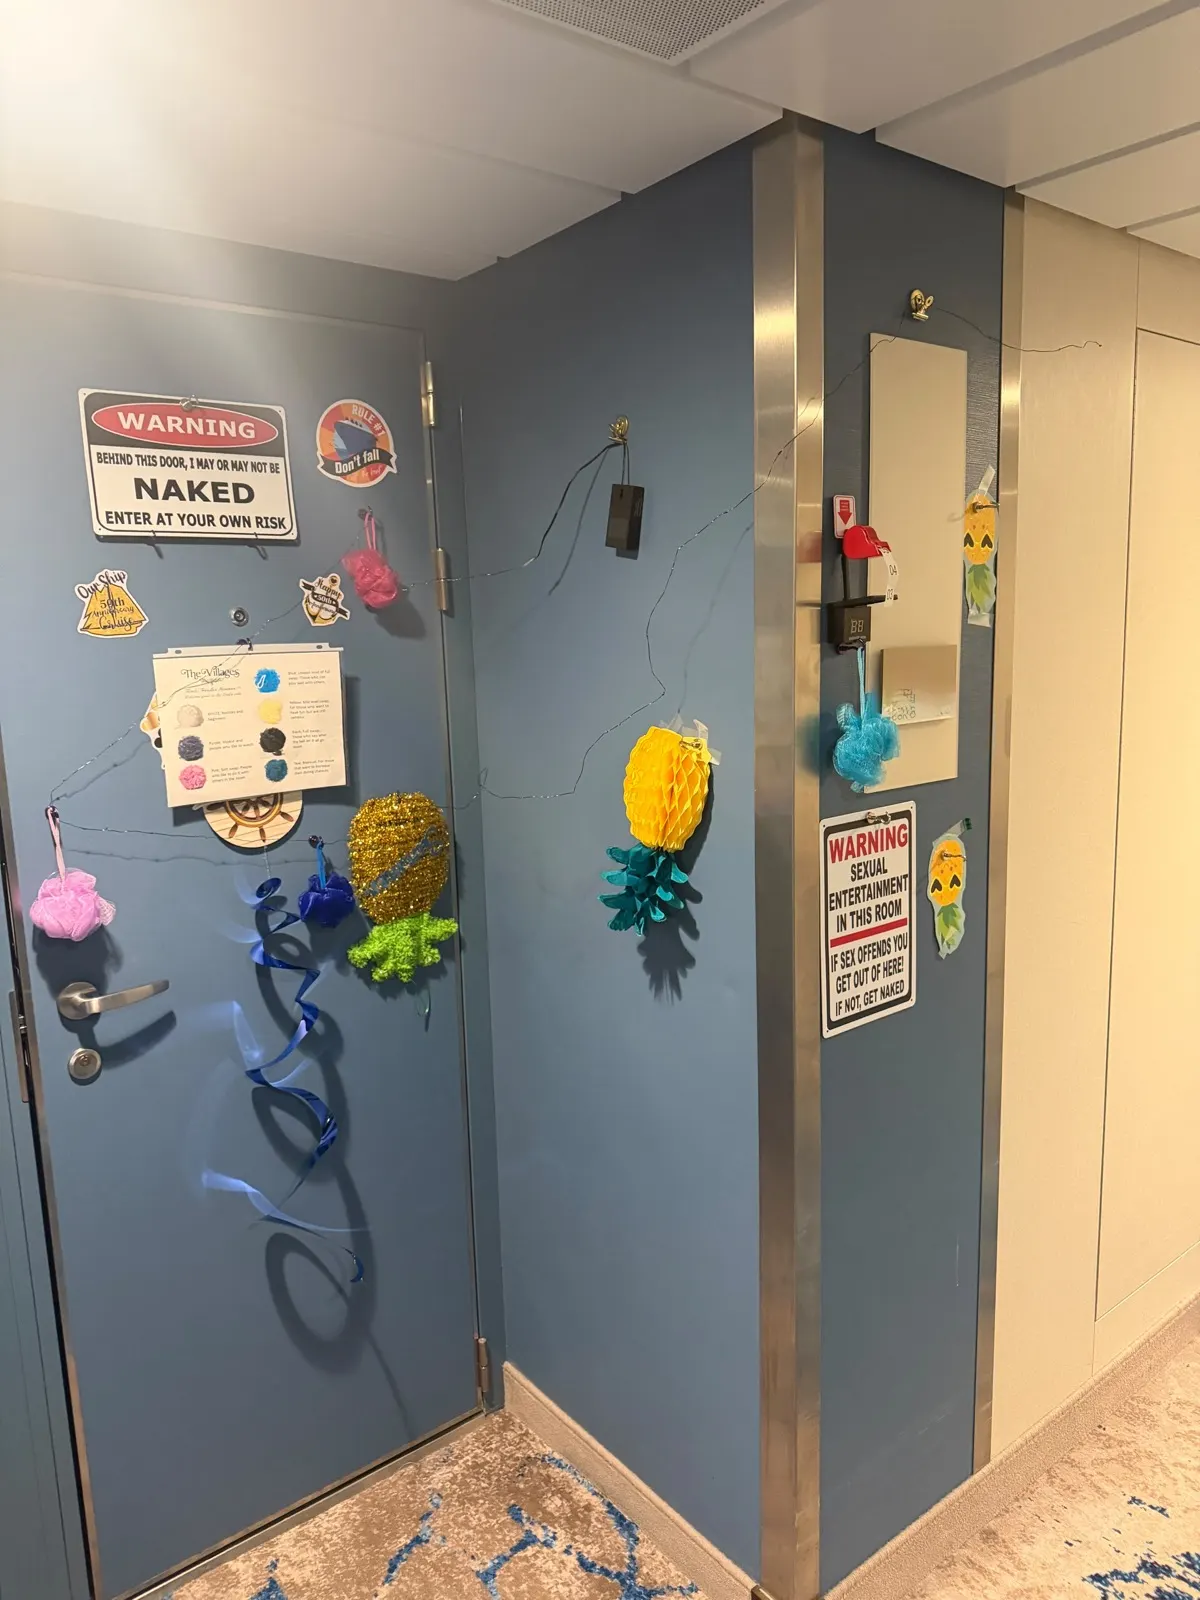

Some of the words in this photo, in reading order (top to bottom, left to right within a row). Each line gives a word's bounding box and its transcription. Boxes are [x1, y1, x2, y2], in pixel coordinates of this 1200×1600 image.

[118, 411, 256, 438] WARNING
[352, 404, 375, 424] RULE
[374, 422, 386, 436] #1
[96, 452, 133, 466] BEHIND
[135, 454, 157, 467] THIS
[160, 455, 188, 470] DOOR,
[190, 457, 195, 469] I
[197, 458, 214, 470] MAY
[217, 459, 229, 471] OR
[231, 460, 248, 473] MAY
[251, 462, 268, 473] NOT
[270, 463, 280, 474] BE
[334, 454, 361, 474] Don't
[363, 449, 380, 463] fall
[134, 478, 255, 504] NAKED
[105, 511, 152, 525] ENTER
[156, 513, 173, 526] AT
[177, 514, 216, 527] YOUR
[219, 515, 251, 528] OWN
[255, 516, 287, 530] RISK
[889, 564, 897, 575] 04
[77, 582, 100, 598] Our
[98, 571, 126, 586] Ship
[181, 669, 201, 679] The
[201, 666, 240, 678] Villages
[829, 823, 908, 864] WARNING
[850, 857, 888, 882] SEXUAL
[829, 874, 908, 911] ENTERTAINMENT
[837, 913, 847, 933] IN
[849, 908, 872, 930] THIS
[875, 898, 902, 921] ROOM
[831, 955, 838, 972] IF
[840, 949, 856, 970] SEX
[858, 939, 892, 964] OFFENDS
[893, 932, 908, 950] YOU
[836, 974, 851, 994] GET
[854, 968, 870, 989] OUT
[871, 963, 880, 982] OF
[882, 956, 904, 980] HERE!
[835, 1000, 842, 1016] IF
[845, 996, 861, 1013] NOT,
[863, 988, 878, 1006] GET
[880, 979, 904, 1000] NAKED
